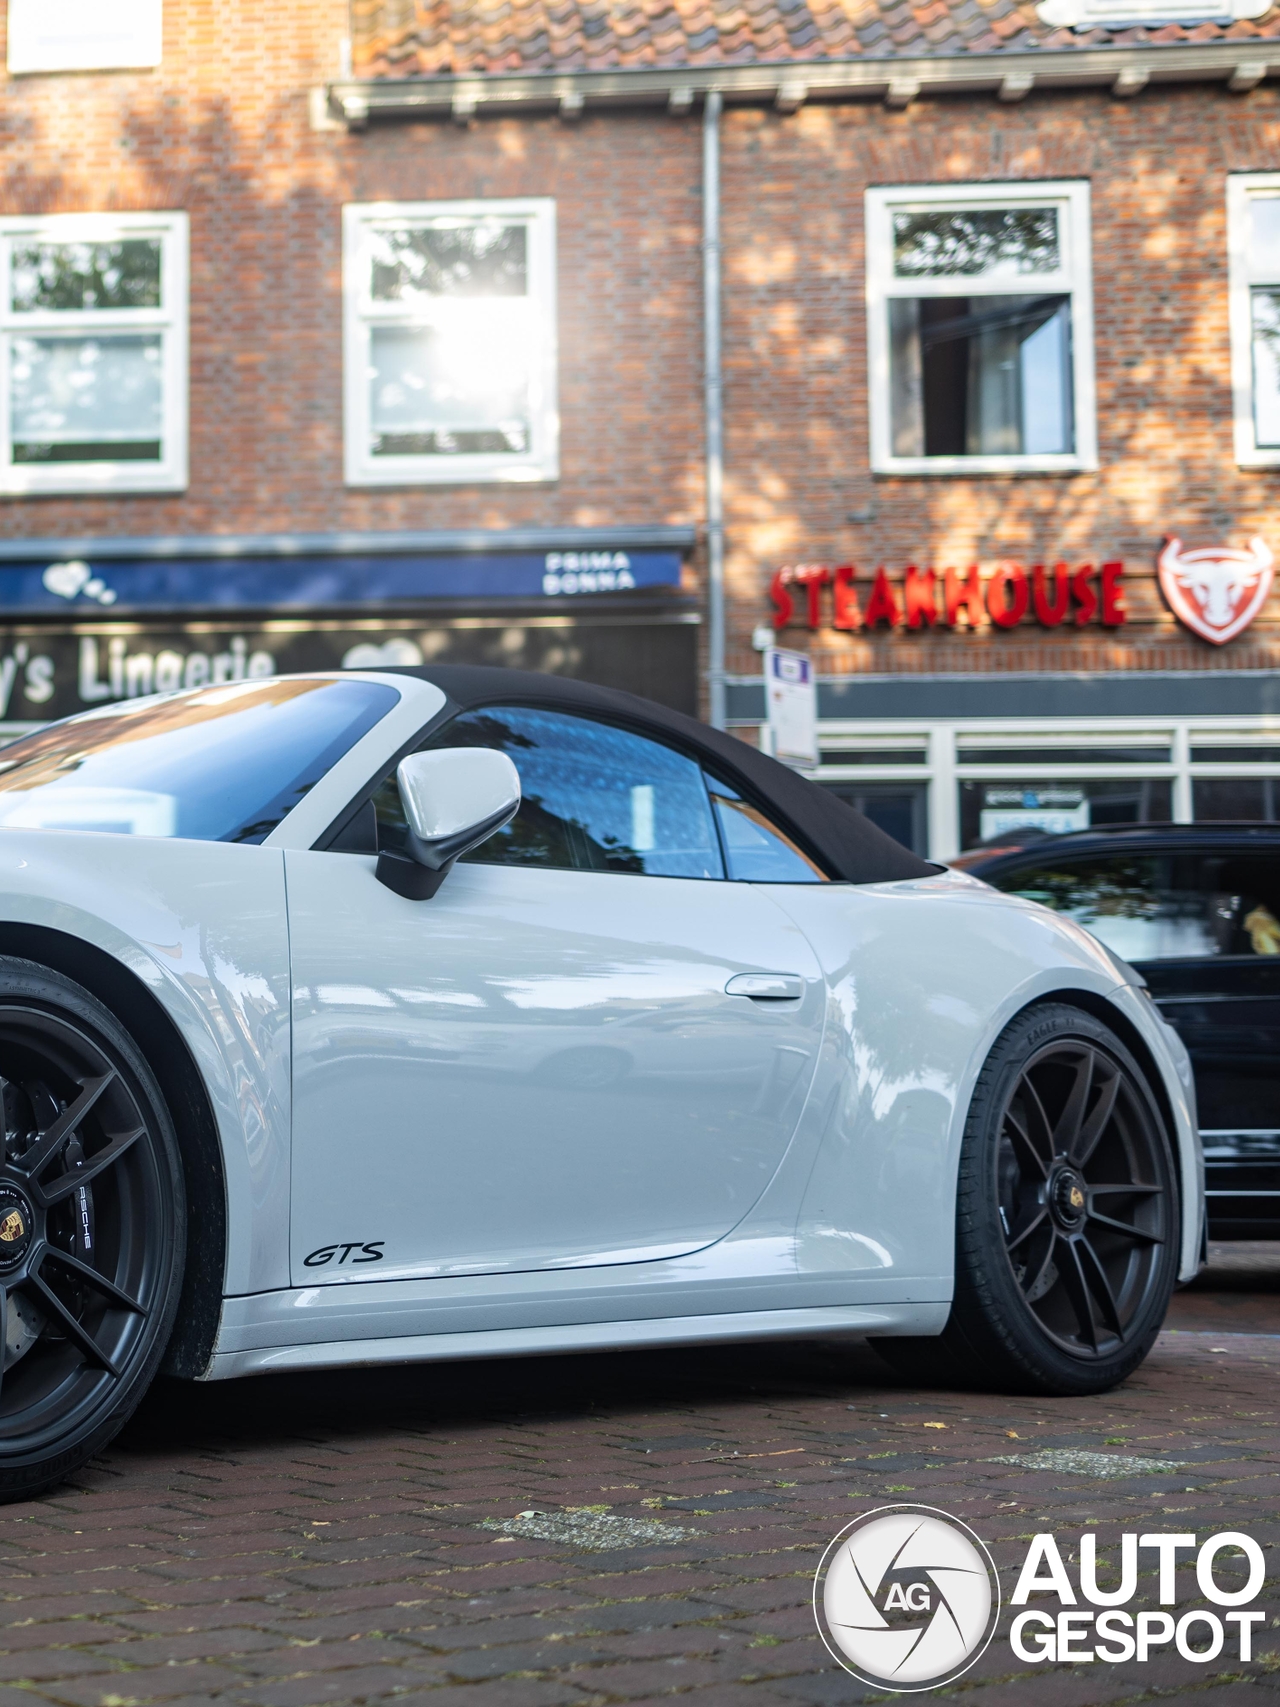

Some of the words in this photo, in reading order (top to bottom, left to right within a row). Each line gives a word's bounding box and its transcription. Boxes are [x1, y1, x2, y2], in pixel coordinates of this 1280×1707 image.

[545, 551, 631, 573] PRIMA
[542, 570, 636, 595] DONNA
[303, 1241, 385, 1267] GTS
